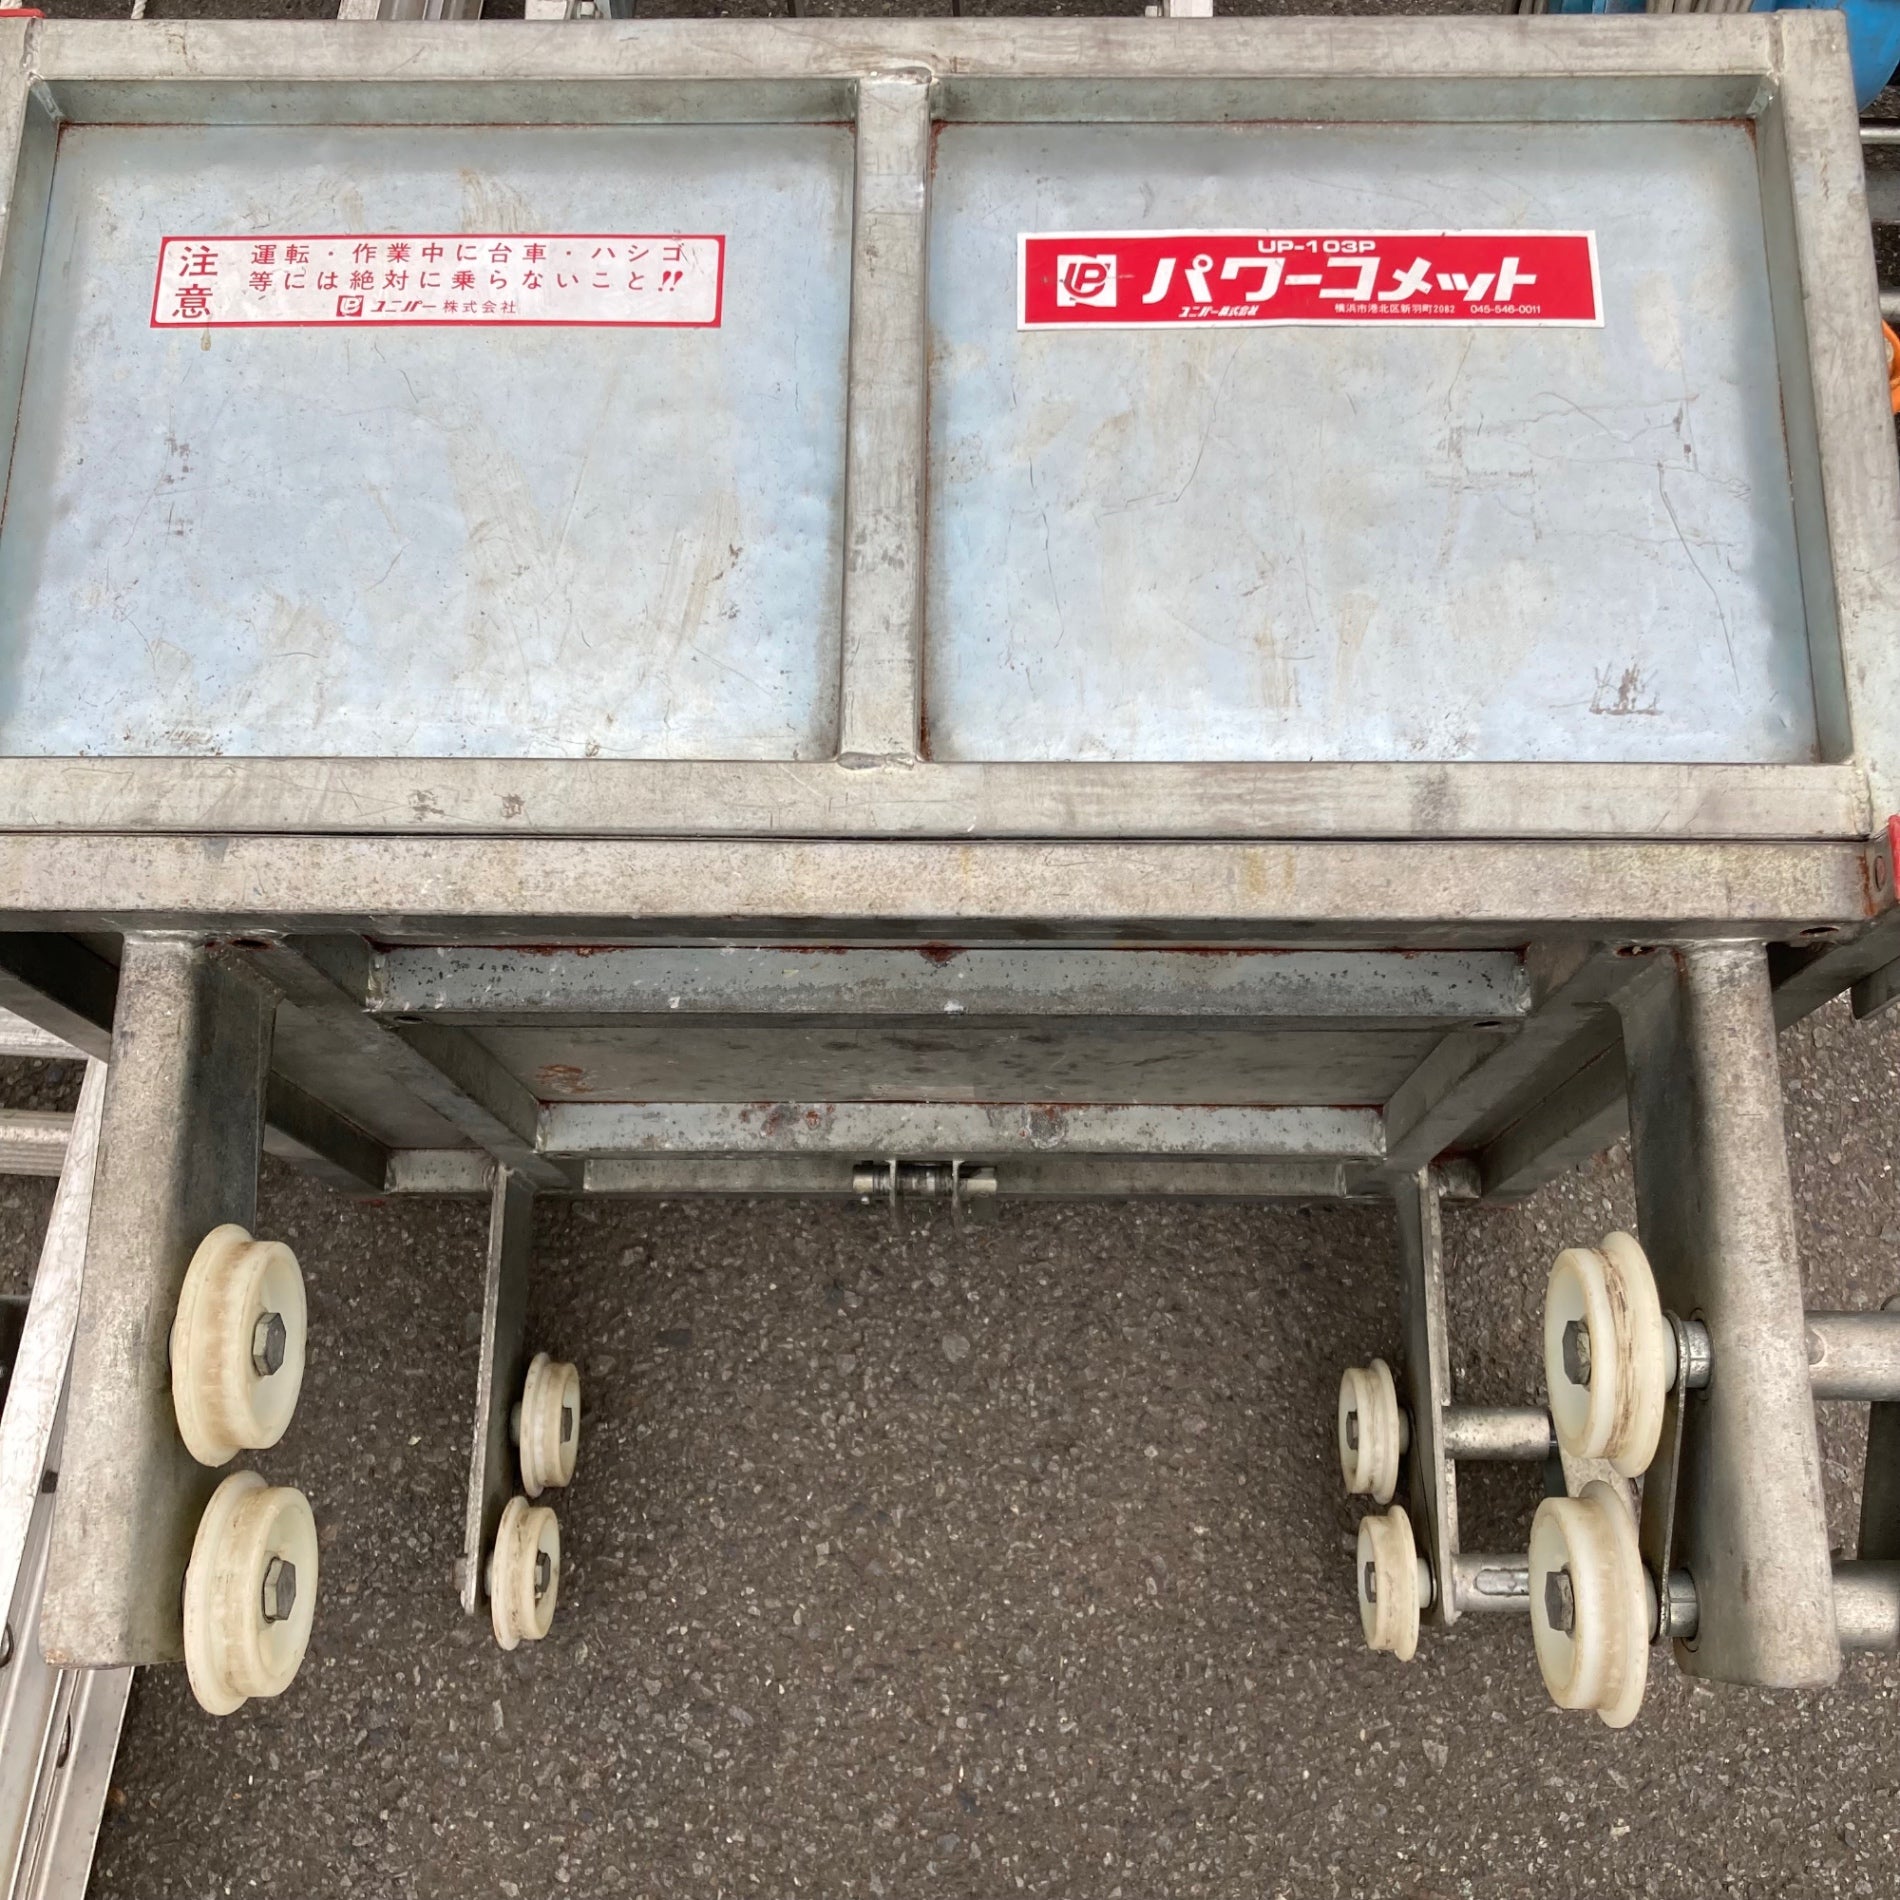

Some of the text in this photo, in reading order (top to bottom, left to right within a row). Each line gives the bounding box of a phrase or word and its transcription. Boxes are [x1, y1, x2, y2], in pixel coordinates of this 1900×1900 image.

[251, 242, 685, 265] 運転・作業中に台車・ハシゴ
[1257, 240, 1376, 254] UP-103P
[172, 245, 219, 319] 注意
[1142, 254, 1538, 304] パワーコメット
[1470, 304, 1541, 314] 045-546-0011
